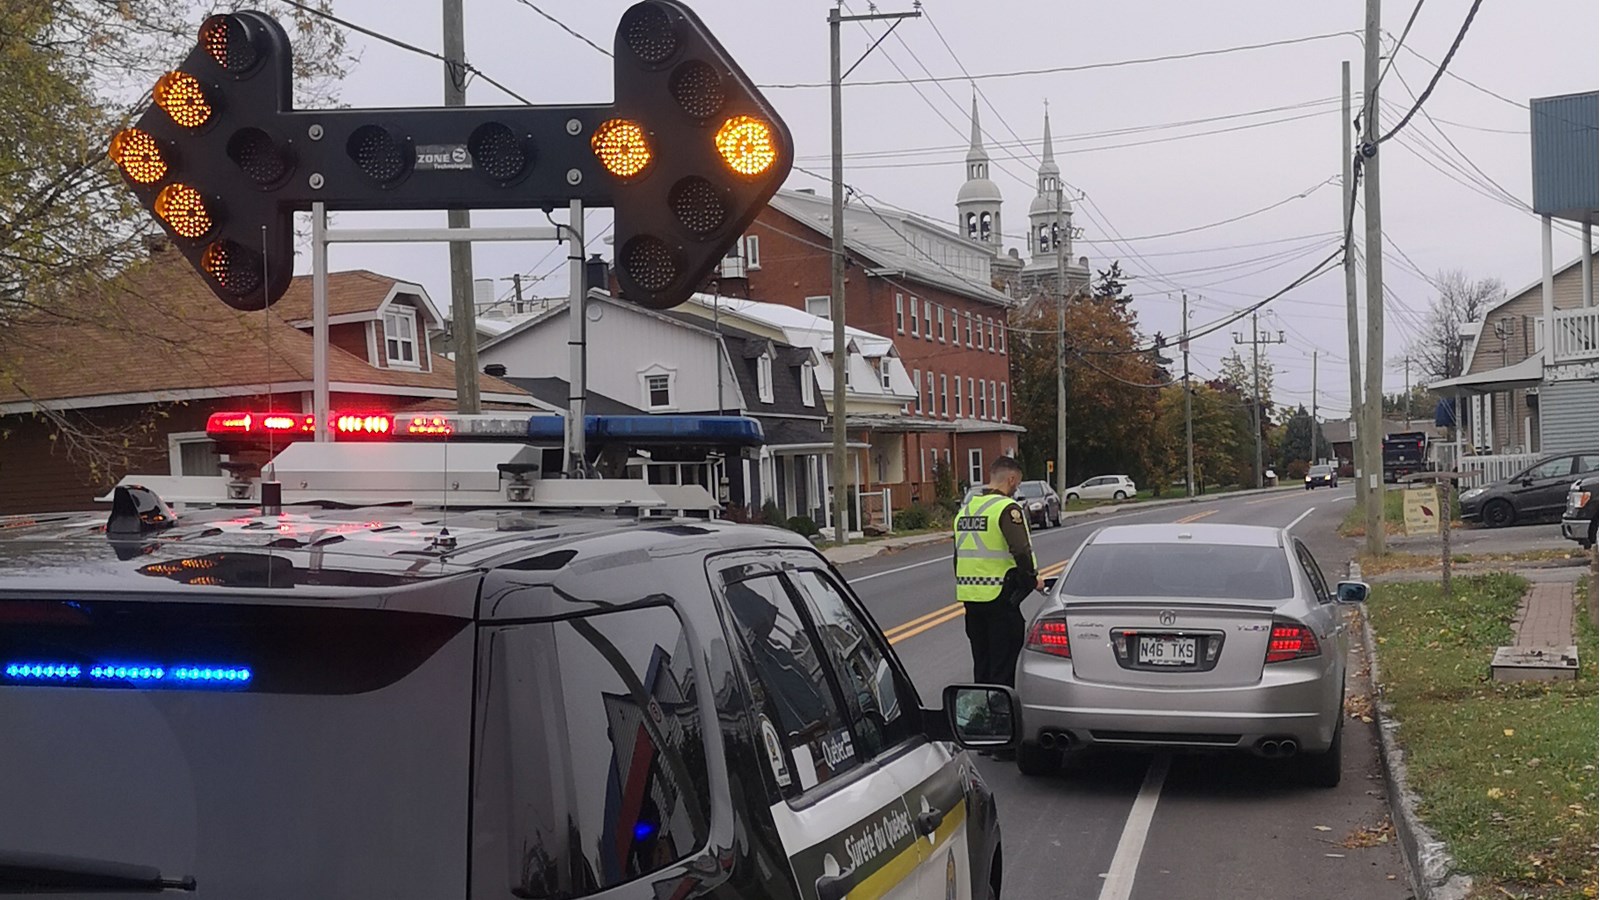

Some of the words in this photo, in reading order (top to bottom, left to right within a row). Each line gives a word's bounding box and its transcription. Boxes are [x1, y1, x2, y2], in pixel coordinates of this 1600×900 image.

[417, 154, 450, 163] ZONE
[958, 517, 986, 529] POLICE
[1140, 642, 1164, 657] N46
[1172, 643, 1194, 658] TKS
[844, 825, 877, 870] Sûreté
[873, 822, 888, 853] du
[883, 809, 911, 849] Québec
